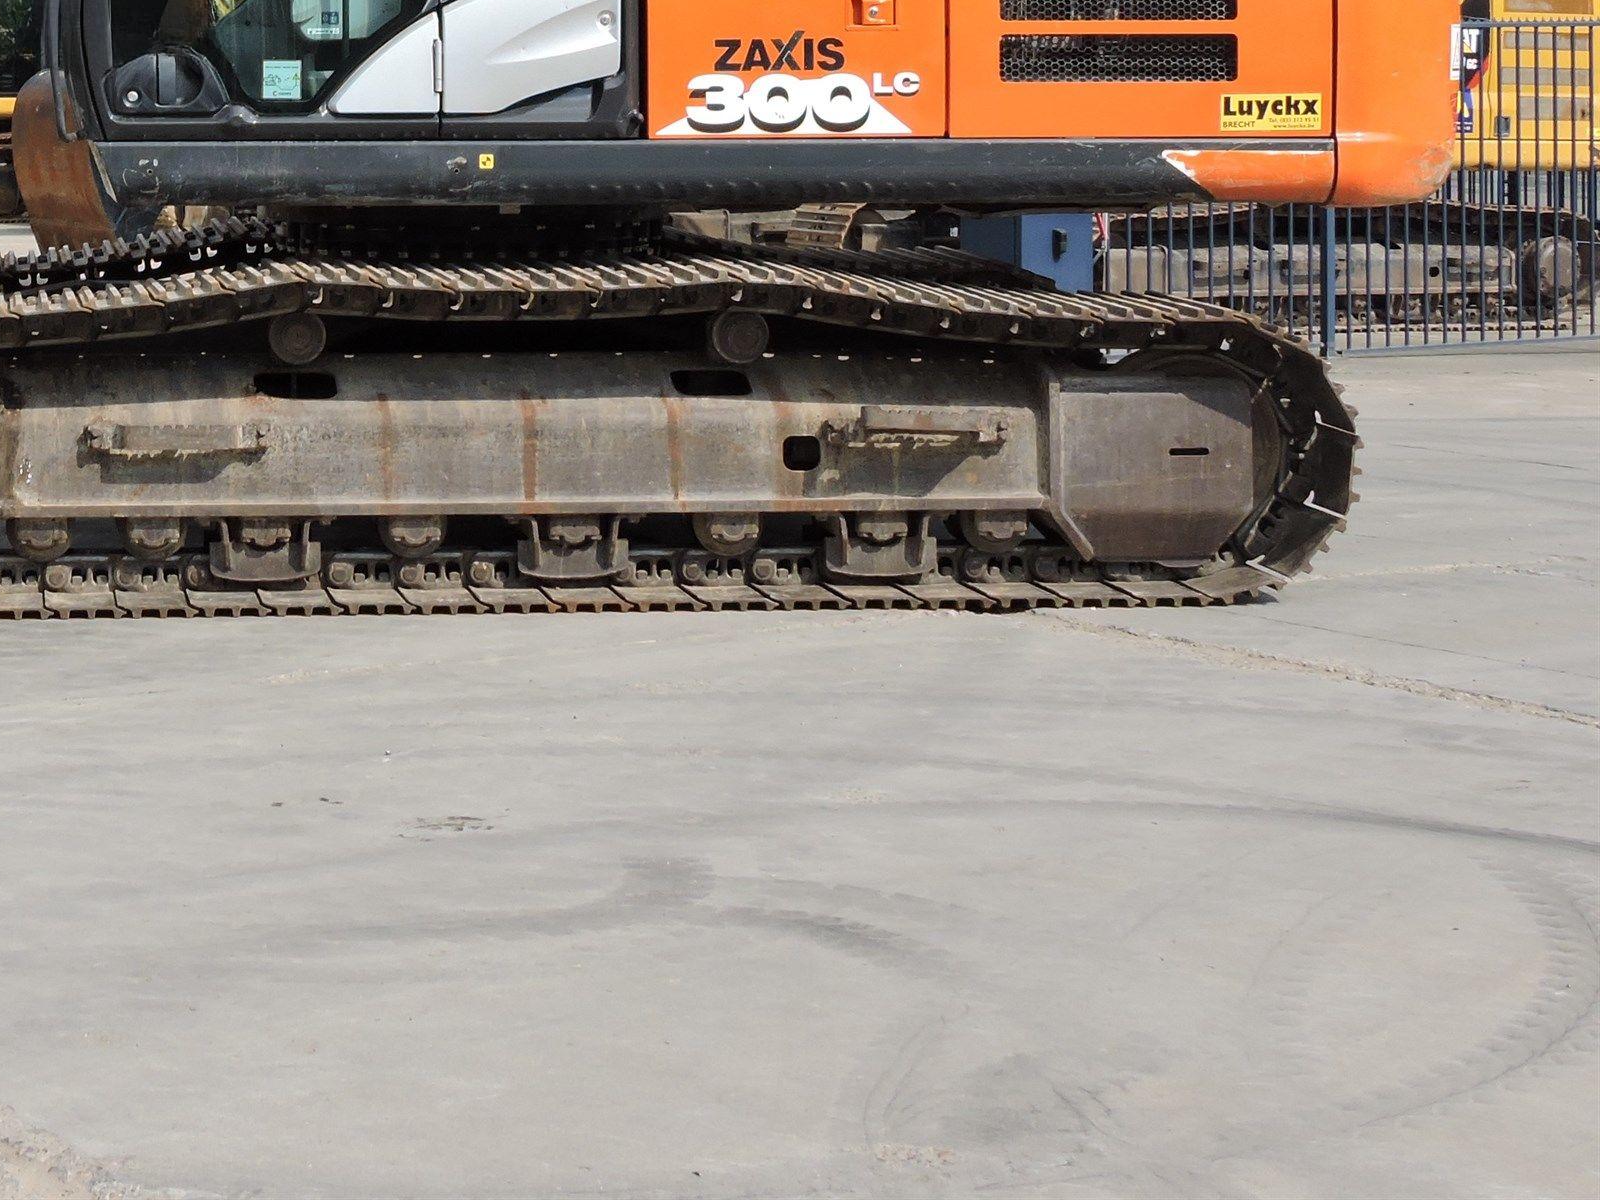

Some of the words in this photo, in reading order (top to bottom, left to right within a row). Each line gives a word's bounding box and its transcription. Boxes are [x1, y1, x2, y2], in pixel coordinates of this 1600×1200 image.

[714, 30, 845, 72] ZAXIS
[686, 73, 871, 133] 300
[873, 71, 920, 97] LC
[1223, 96, 1318, 120] Luyckx
